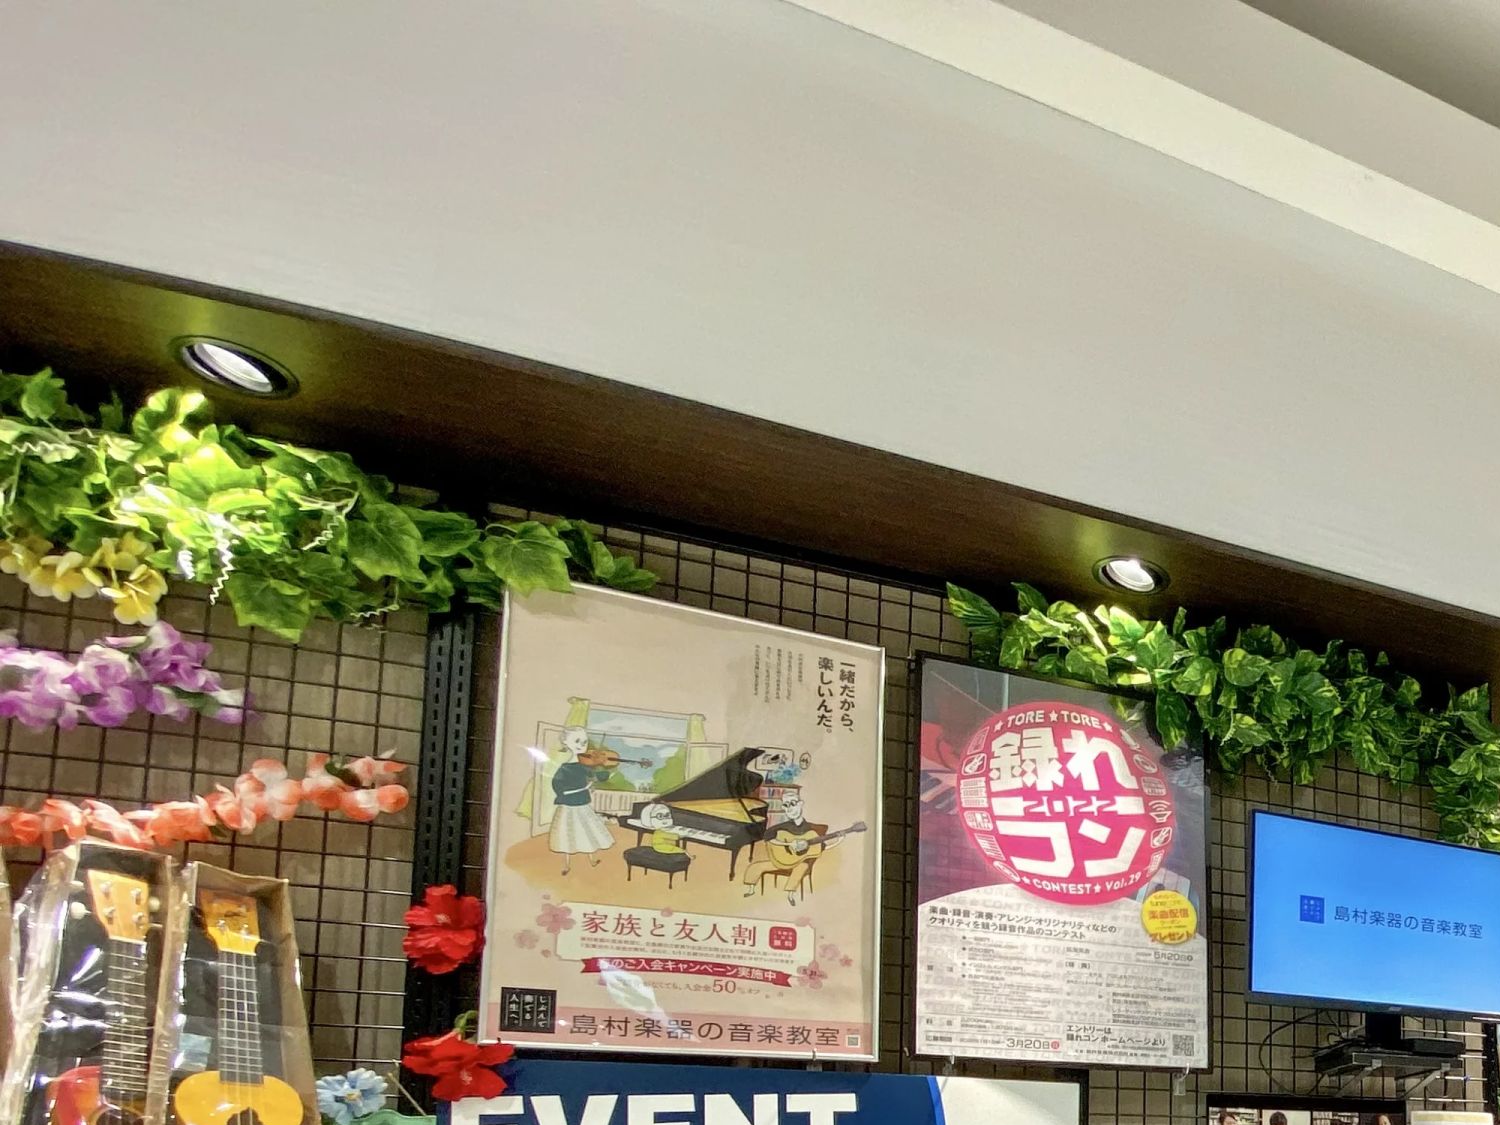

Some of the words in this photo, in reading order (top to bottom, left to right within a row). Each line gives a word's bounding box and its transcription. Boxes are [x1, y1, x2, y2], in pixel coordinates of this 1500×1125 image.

[817, 656, 834, 734] 楽しいんだ。
[840, 661, 856, 732] 一緒だから、
[1007, 710, 1045, 727] TORE
[1061, 710, 1103, 729] TORE
[1033, 878, 1091, 895] CONTEST
[581, 910, 757, 947] 家族と友人割
[1334, 905, 1483, 939] 島村楽器の音楽教室
[569, 1014, 840, 1047] 島村楽器の音楽教室
